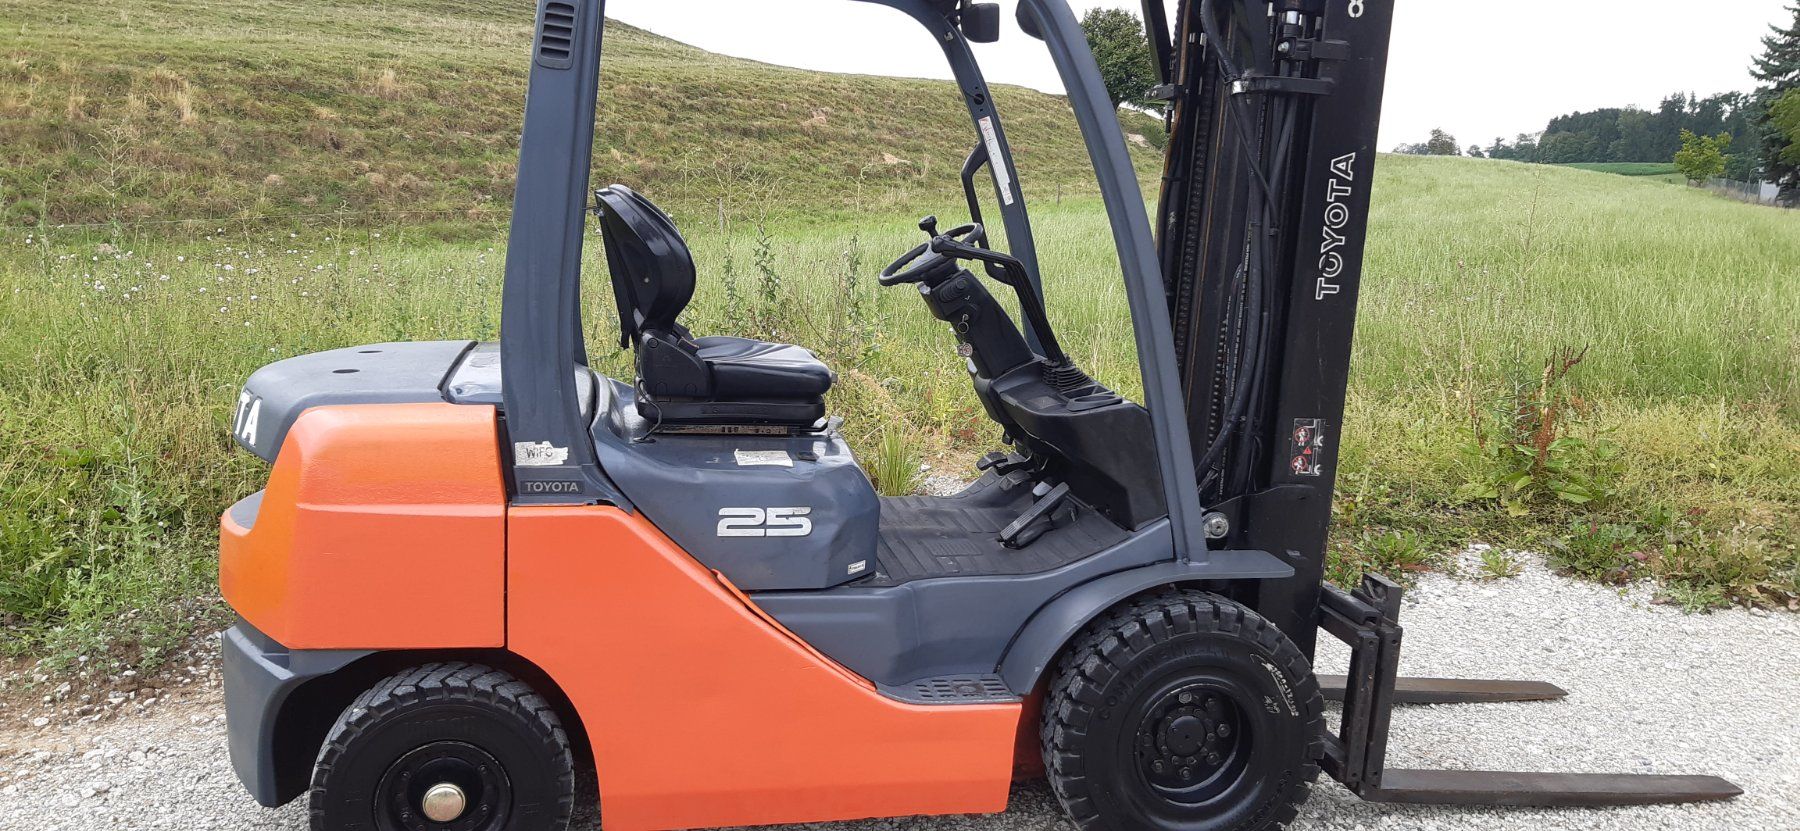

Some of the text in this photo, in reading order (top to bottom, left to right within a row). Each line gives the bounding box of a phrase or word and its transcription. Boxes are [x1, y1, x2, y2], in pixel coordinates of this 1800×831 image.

[1315, 152, 1356, 300] TOYOTA
[525, 481, 579, 492] TOYOTA
[717, 506, 813, 537] 25
